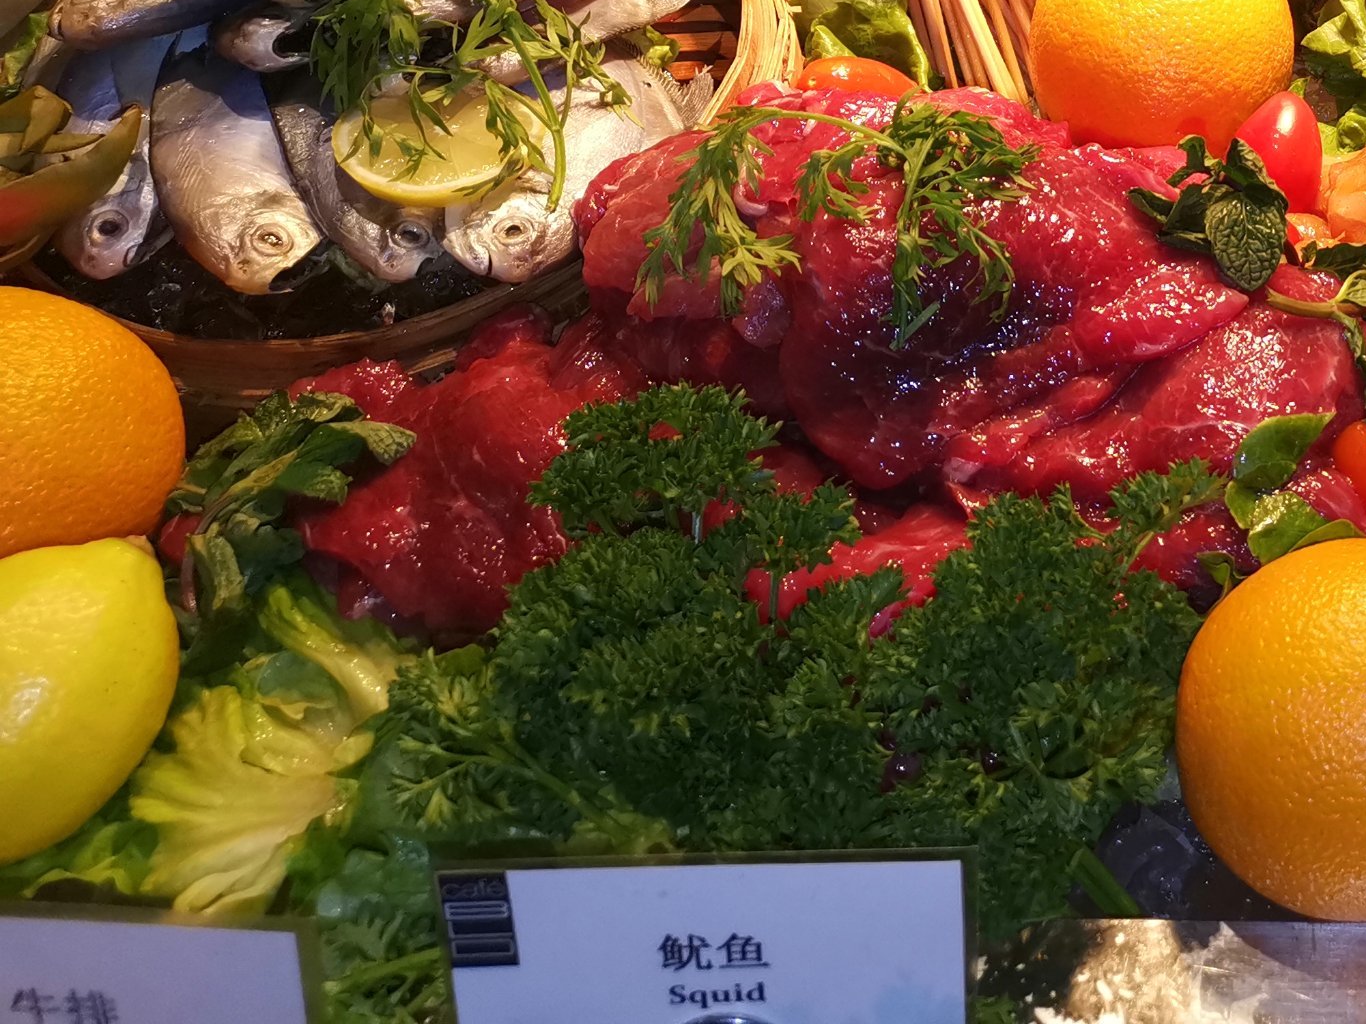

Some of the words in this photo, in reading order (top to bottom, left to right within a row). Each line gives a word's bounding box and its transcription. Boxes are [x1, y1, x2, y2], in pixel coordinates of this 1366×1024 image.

[657, 932, 770, 971] 鱿鱼
[10, 987, 119, 1024] 牛排
[668, 981, 766, 1008] Squid
